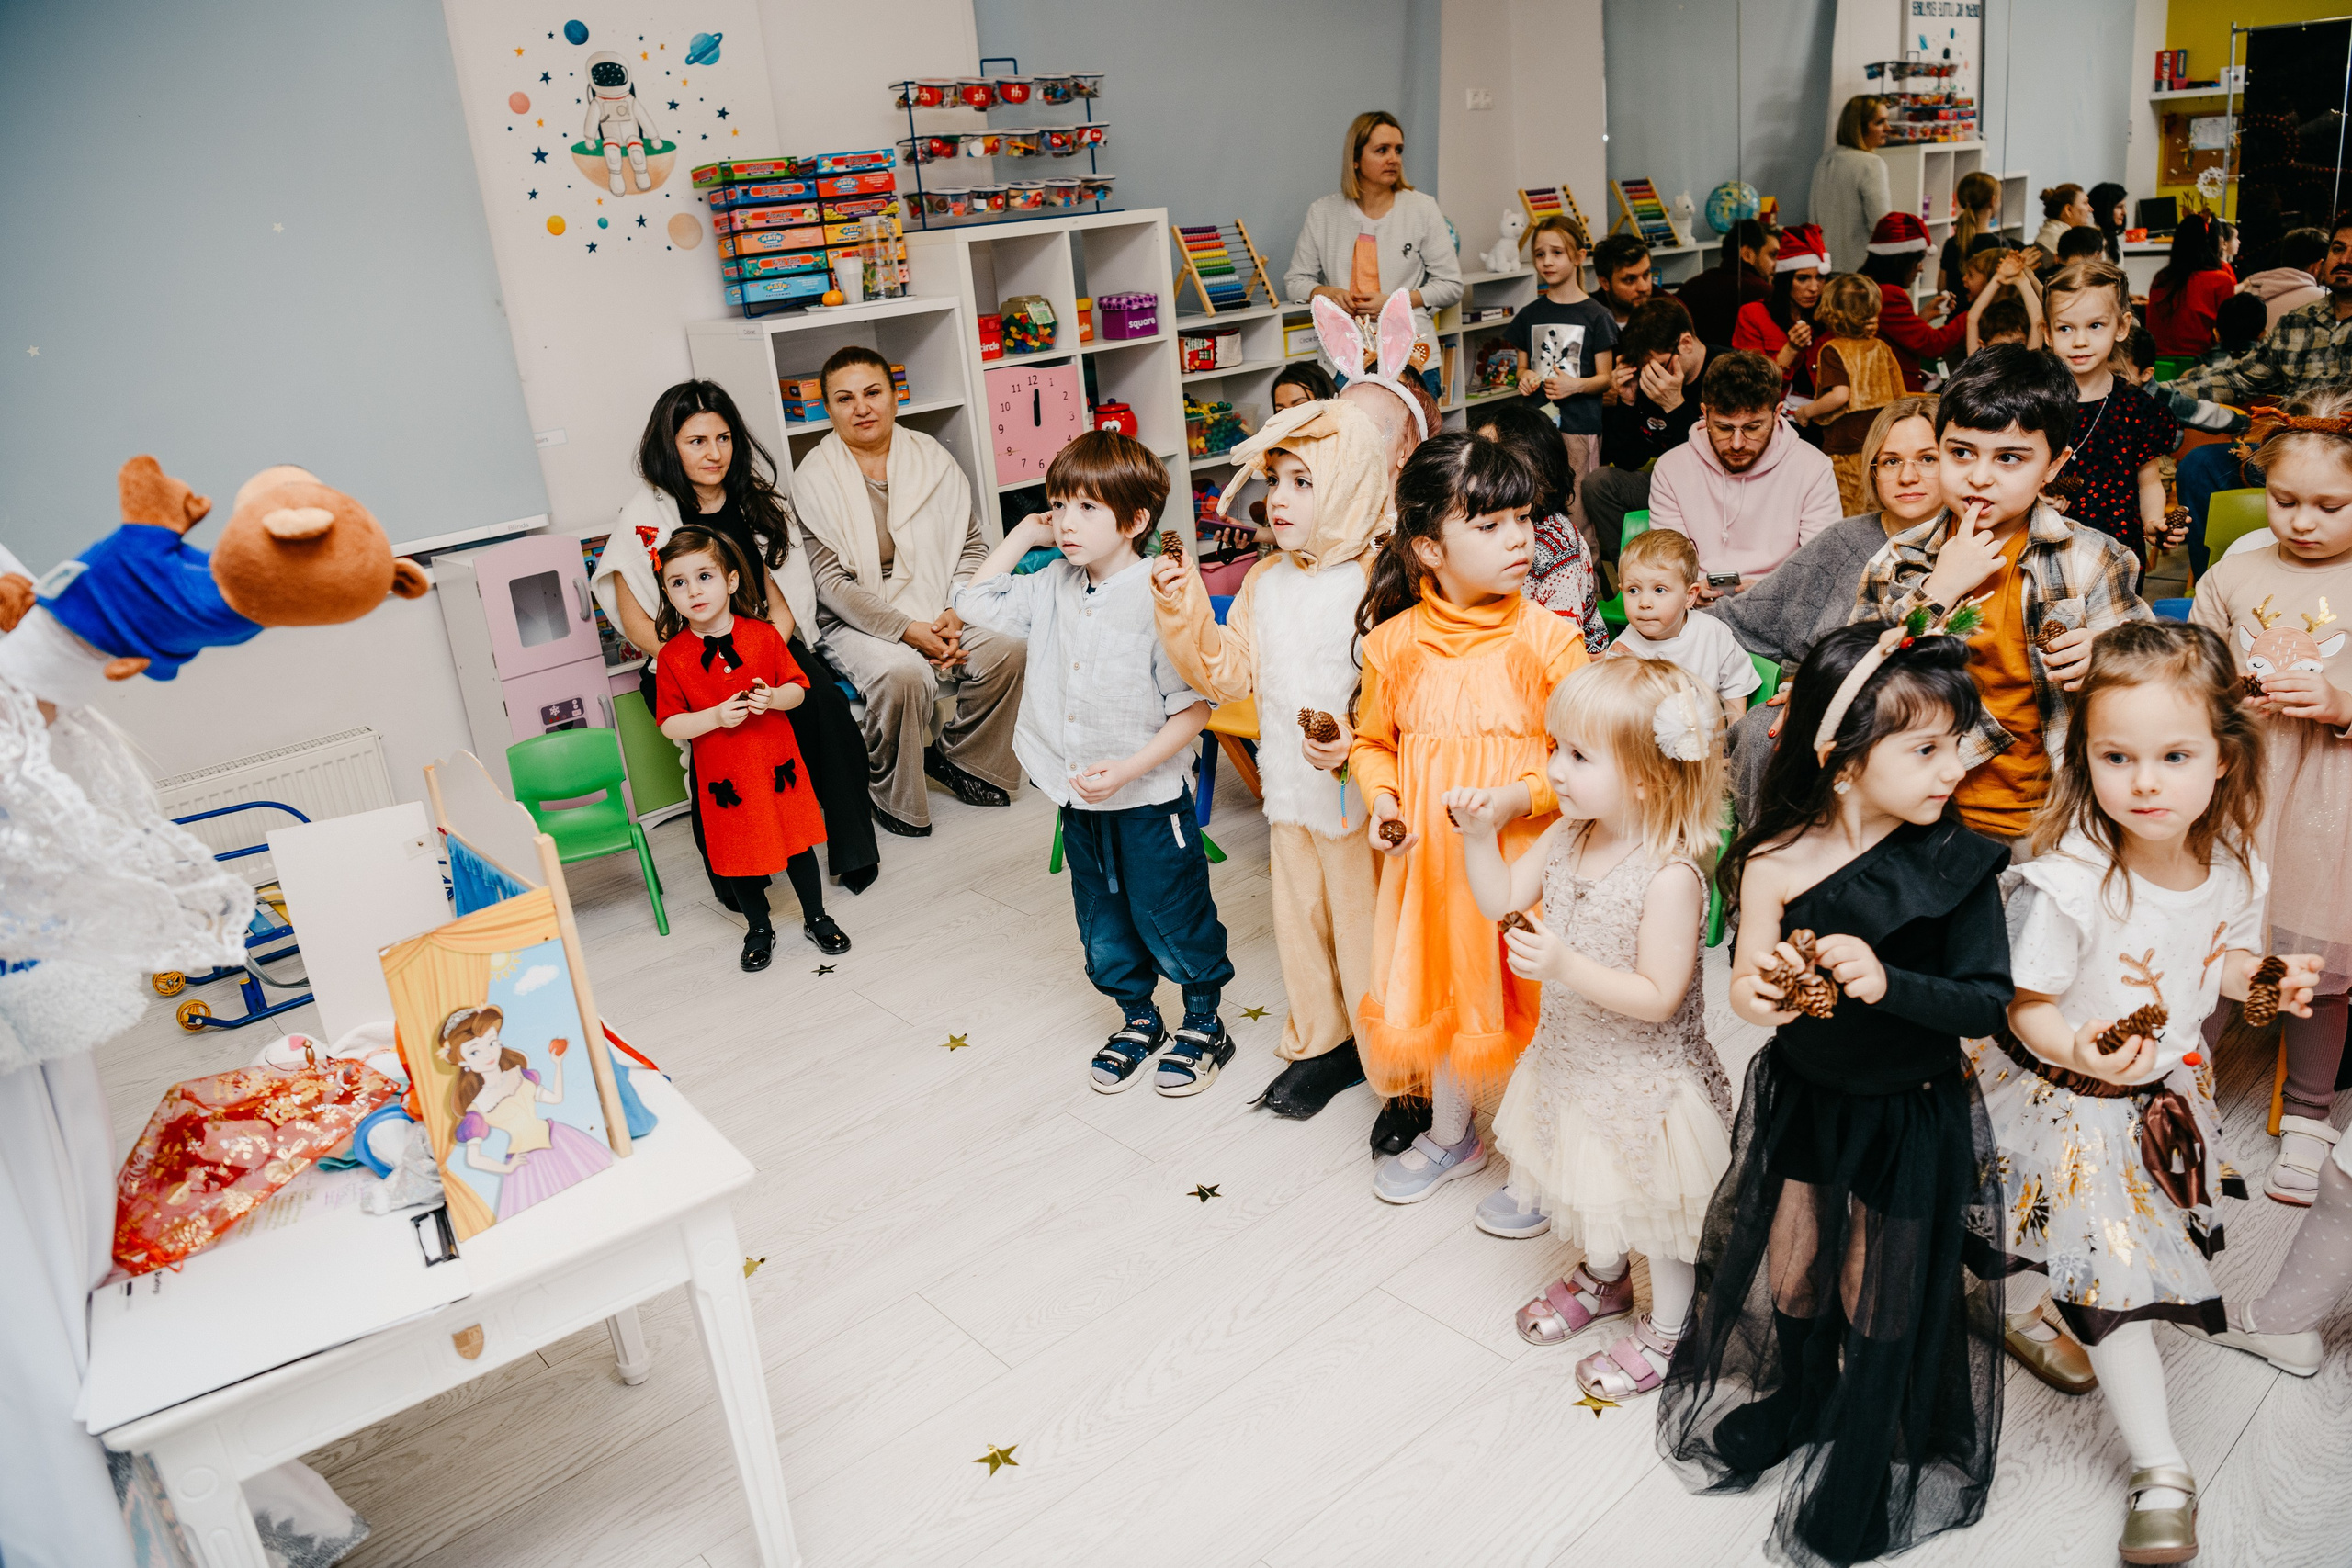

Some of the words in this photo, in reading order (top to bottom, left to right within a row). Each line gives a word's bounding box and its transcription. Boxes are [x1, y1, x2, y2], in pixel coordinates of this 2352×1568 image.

[974, 89, 985, 101] sh
[1011, 85, 1021, 97] th
[1129, 317, 1155, 329] square
[1028, 375, 1038, 386] 12
[1050, 378, 1053, 386] 1
[1012, 384, 1021, 393] 11
[1063, 391, 1068, 400] 2
[1001, 402, 1010, 412] 10
[1069, 411, 1074, 421] 3
[998, 424, 1004, 434] 9
[1007, 447, 1012, 456] 8
[1021, 459, 1026, 467] 7
[1039, 459, 1044, 469] 6
[508, 522, 529, 531] Blinds
